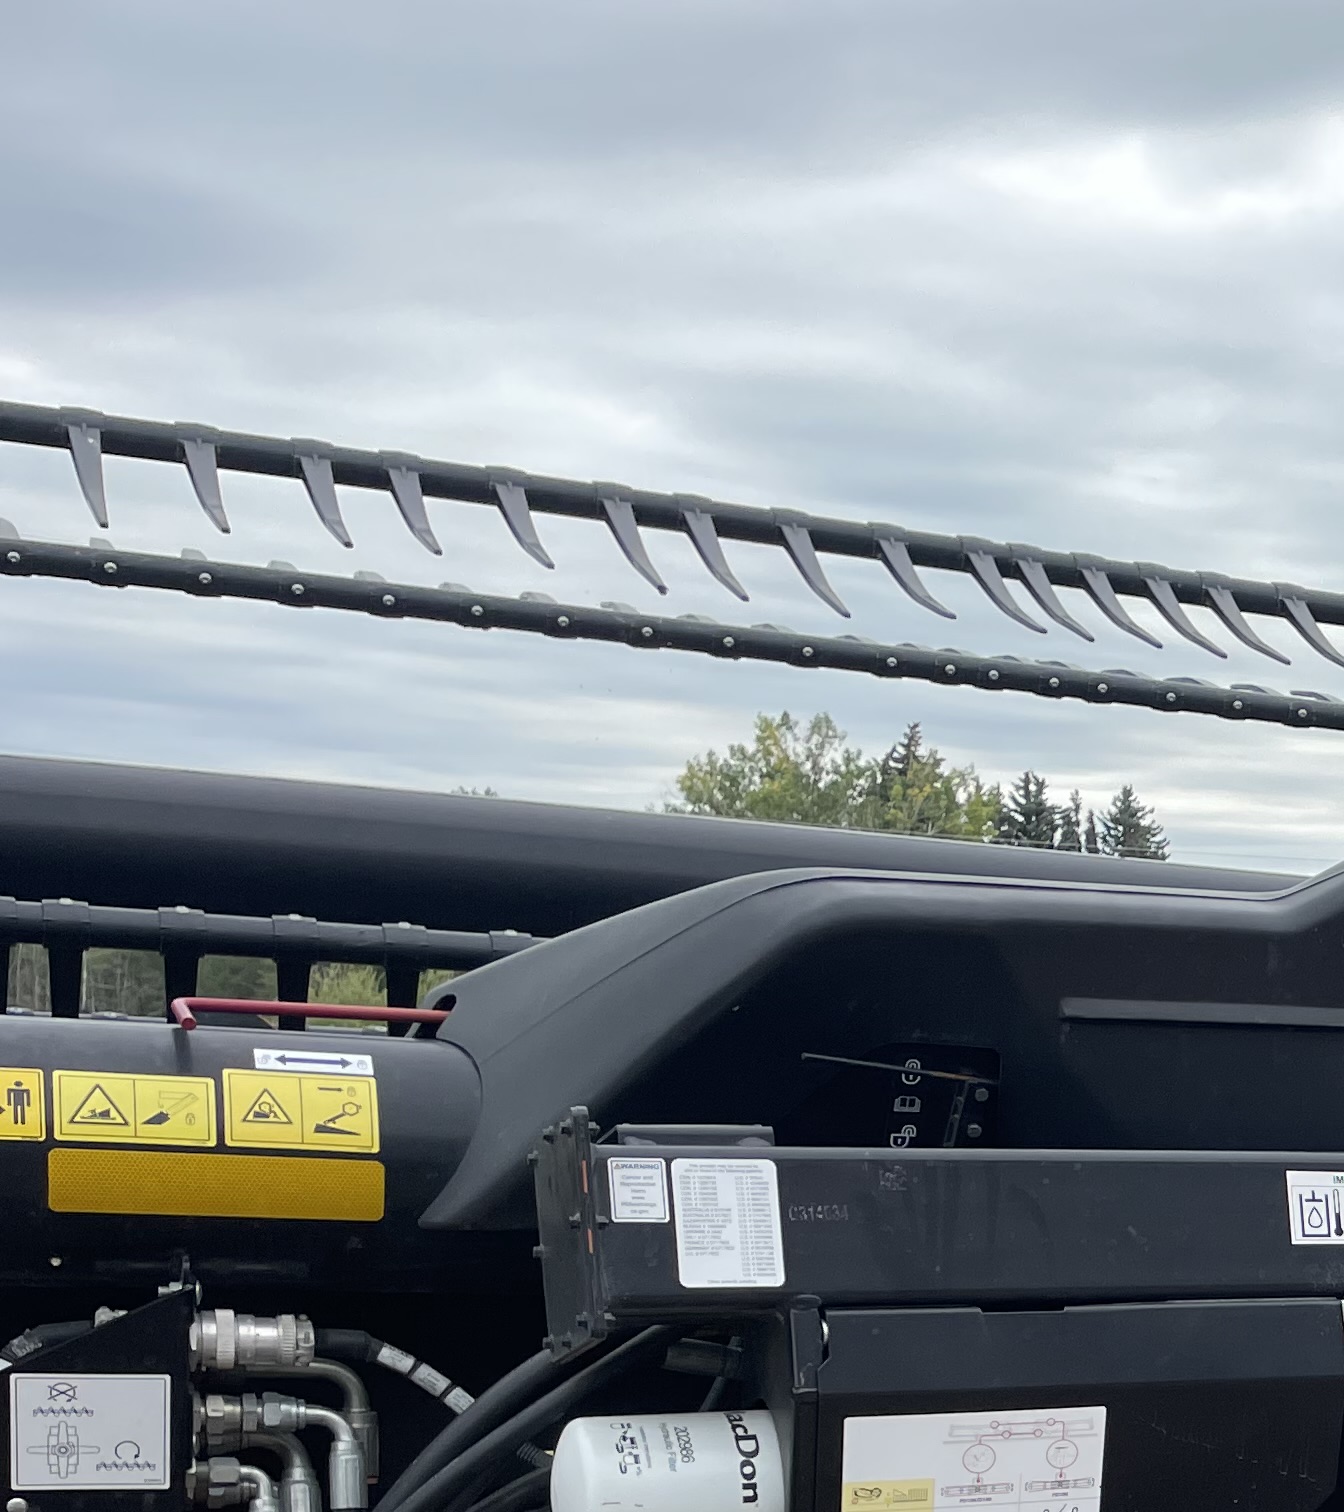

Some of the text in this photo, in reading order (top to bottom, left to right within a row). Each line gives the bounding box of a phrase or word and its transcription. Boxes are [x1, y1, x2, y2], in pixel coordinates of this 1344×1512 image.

[667, 1451, 677, 1473] Filter
[673, 1426, 696, 1463] 202986
[723, 1411, 760, 1504] acDon
